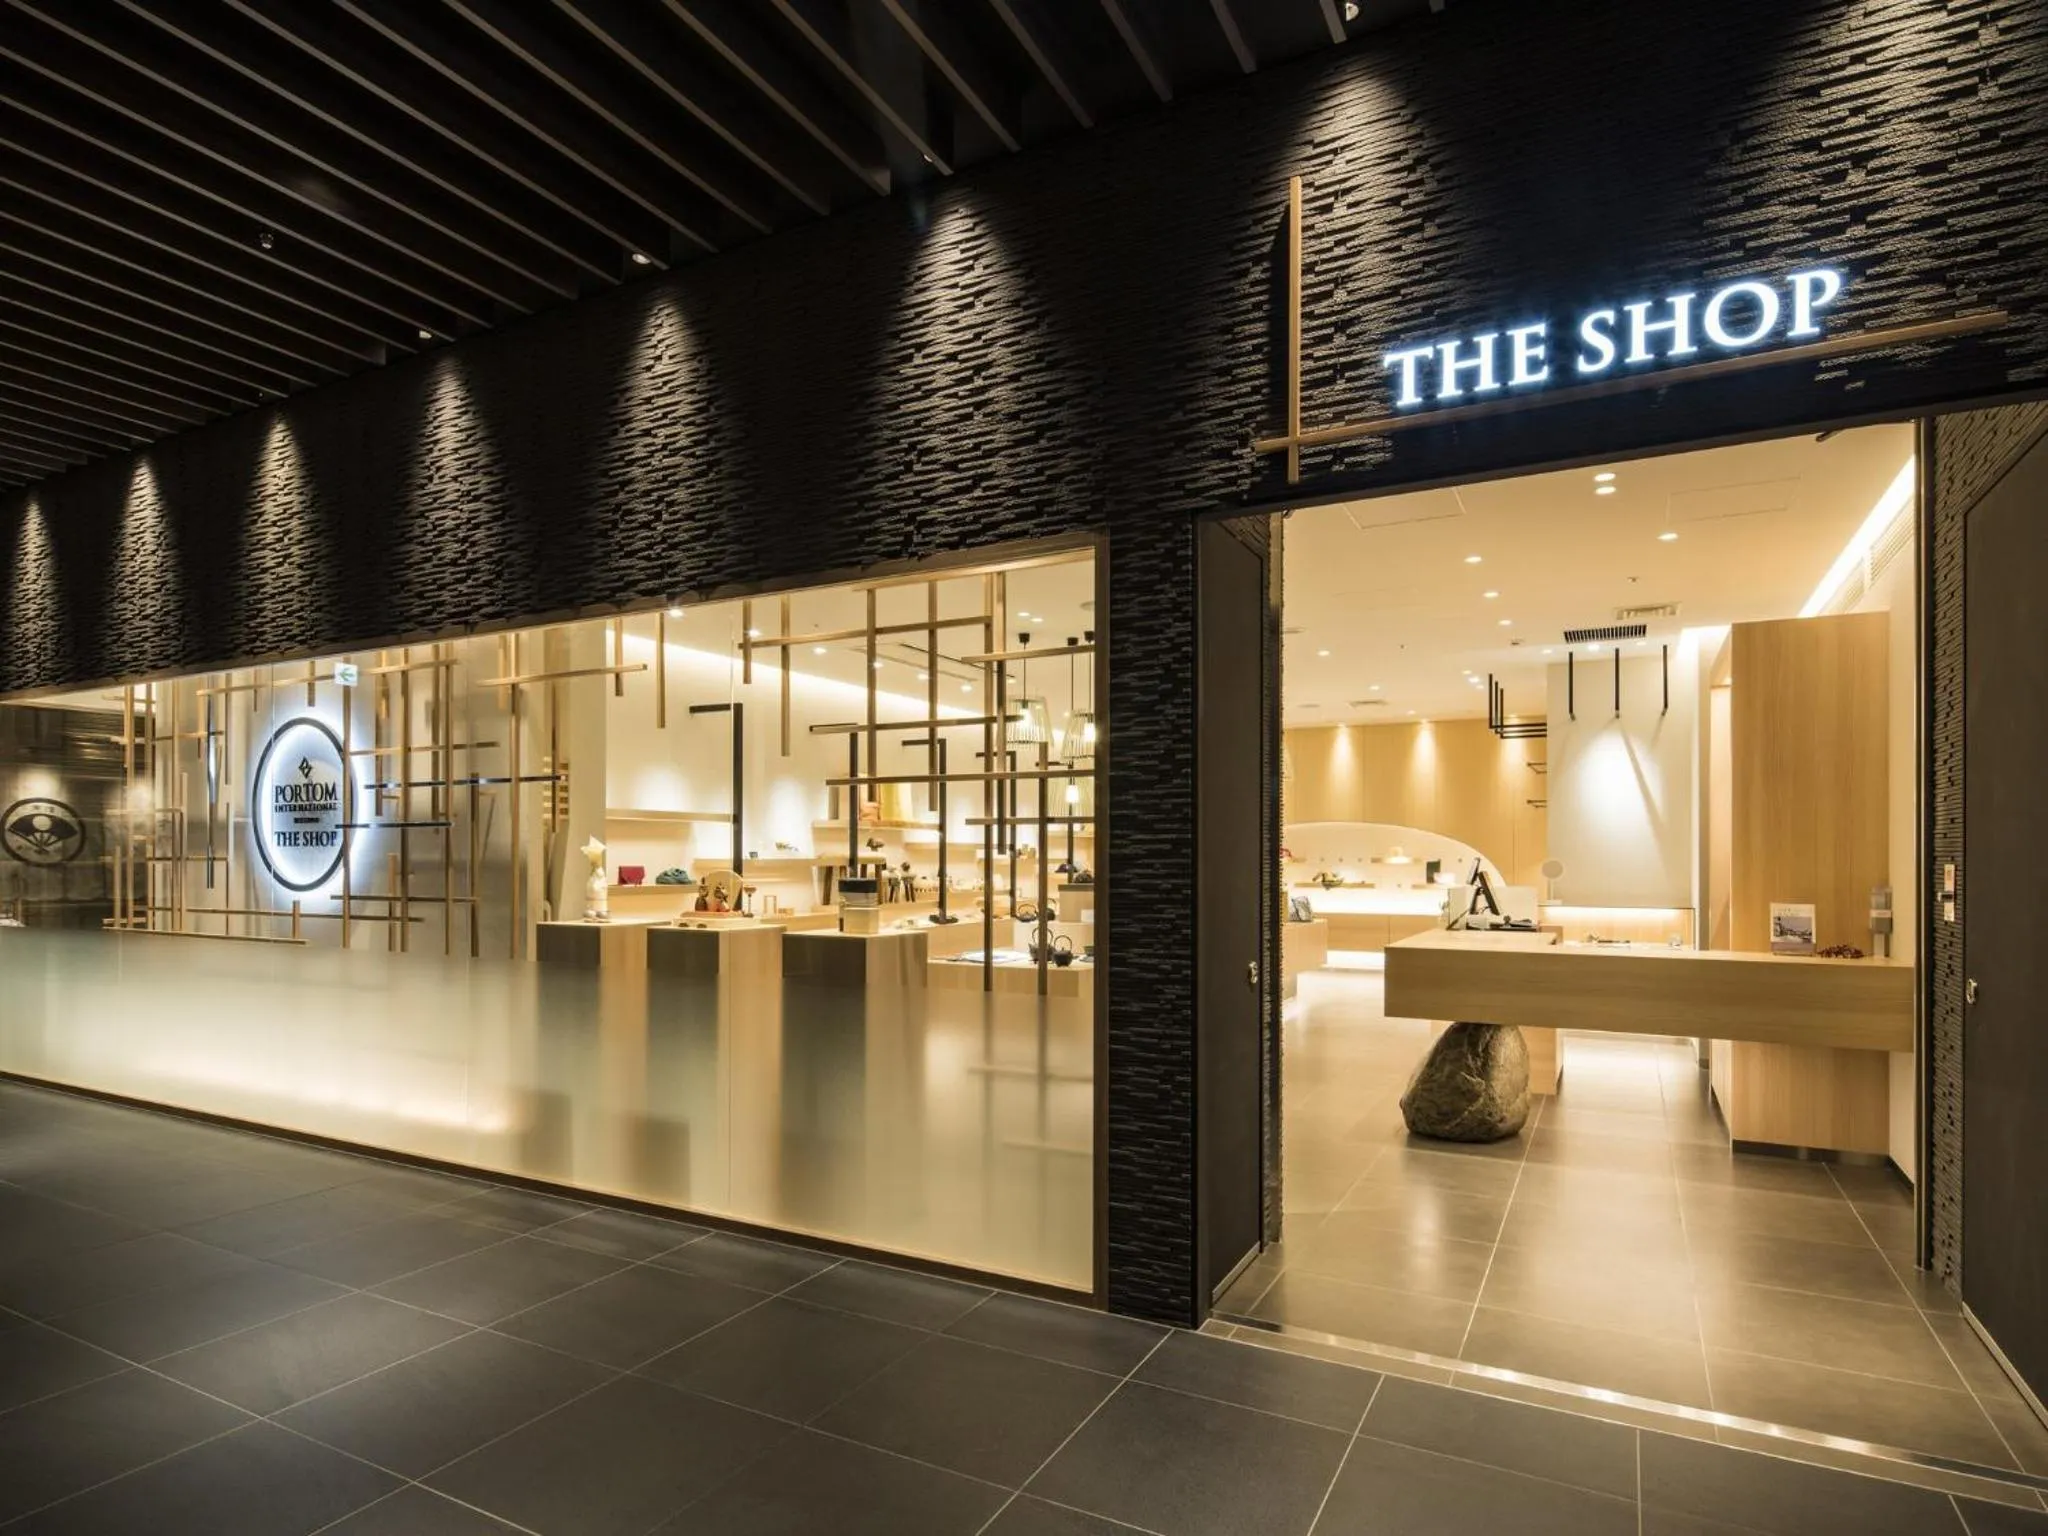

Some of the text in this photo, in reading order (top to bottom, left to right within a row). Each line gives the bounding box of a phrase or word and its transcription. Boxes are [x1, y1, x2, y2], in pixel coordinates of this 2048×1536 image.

[1383, 269, 1841, 406] THE SHOP
[275, 781, 338, 803] PORTOM
[275, 830, 338, 847] THE SHOP
